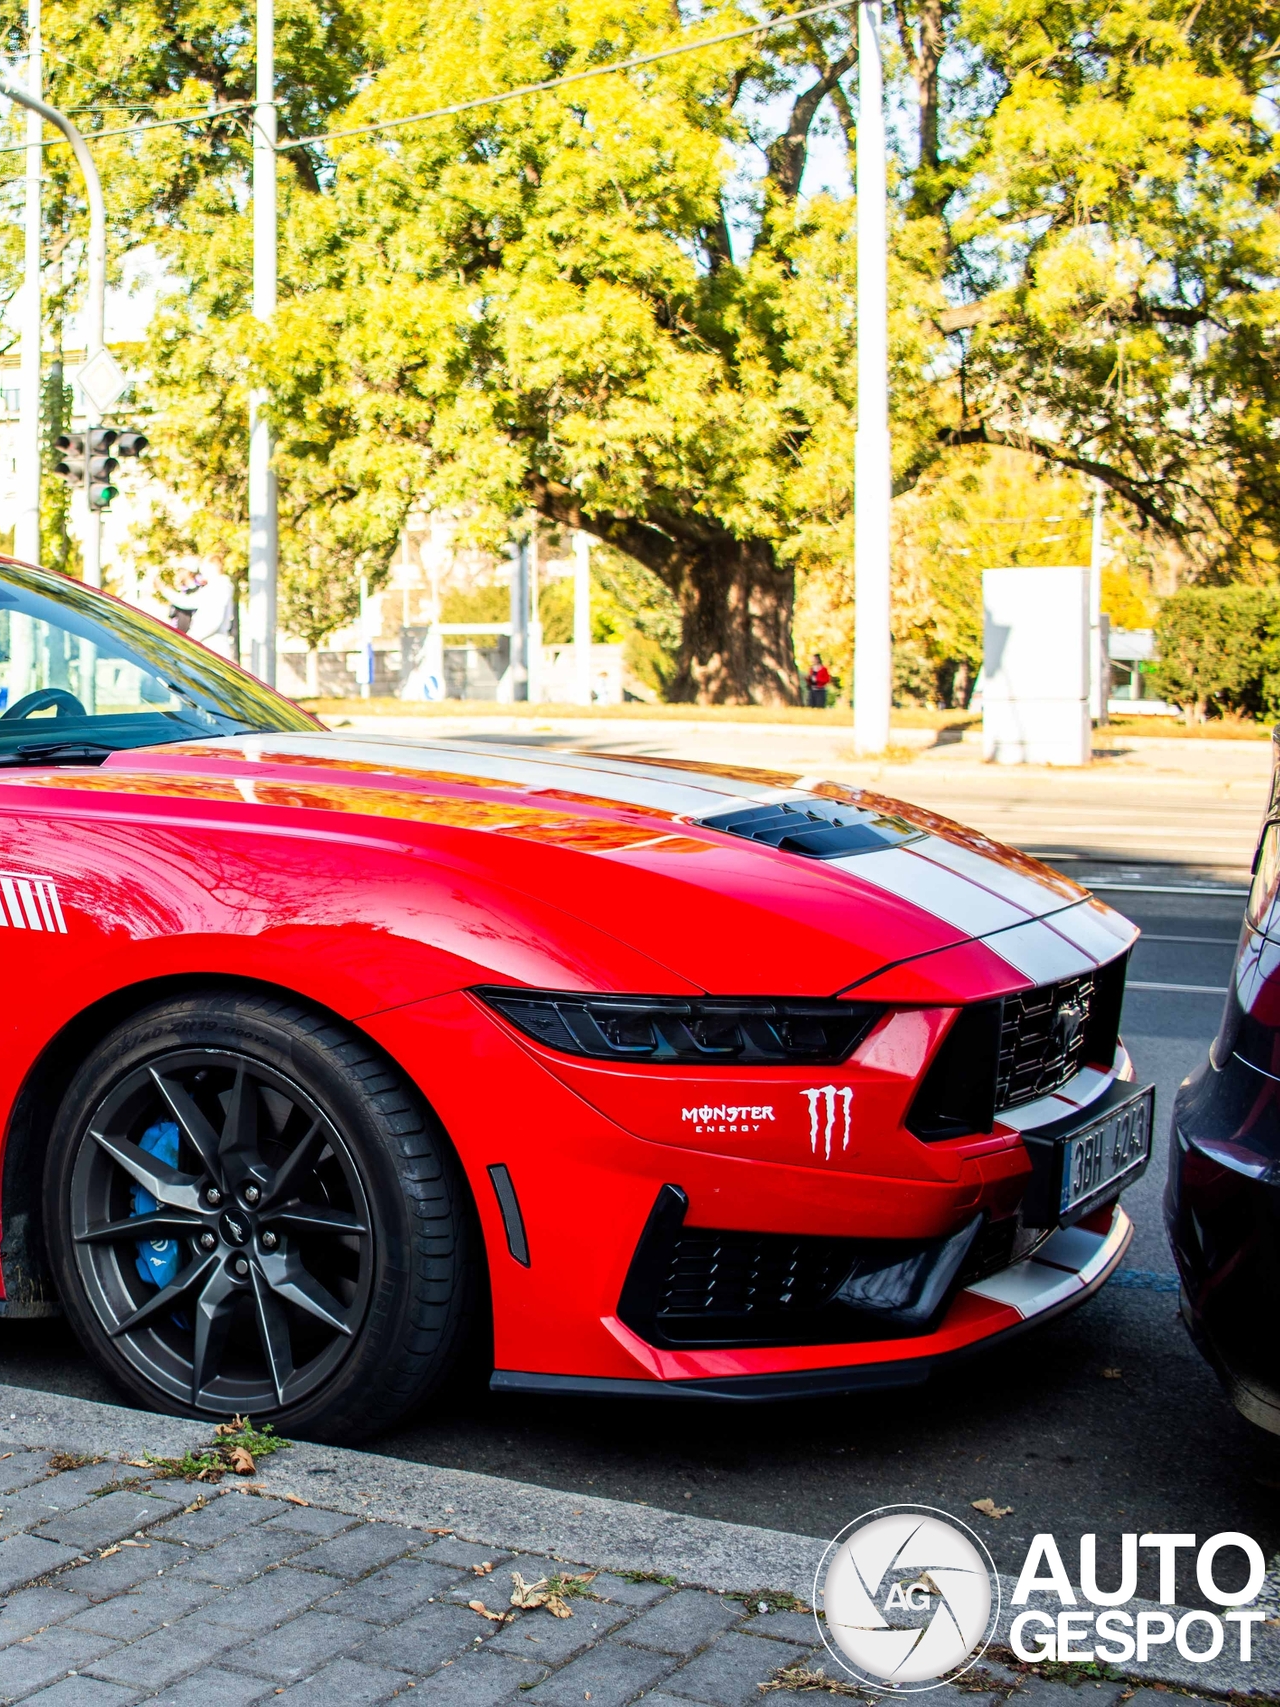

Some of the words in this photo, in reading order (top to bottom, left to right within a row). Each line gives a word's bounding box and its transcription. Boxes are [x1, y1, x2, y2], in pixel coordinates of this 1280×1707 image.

[681, 1104, 776, 1124] MONSTER
[695, 1124, 760, 1133] ENERGY
[1072, 1128, 1104, 1197] 3BH
